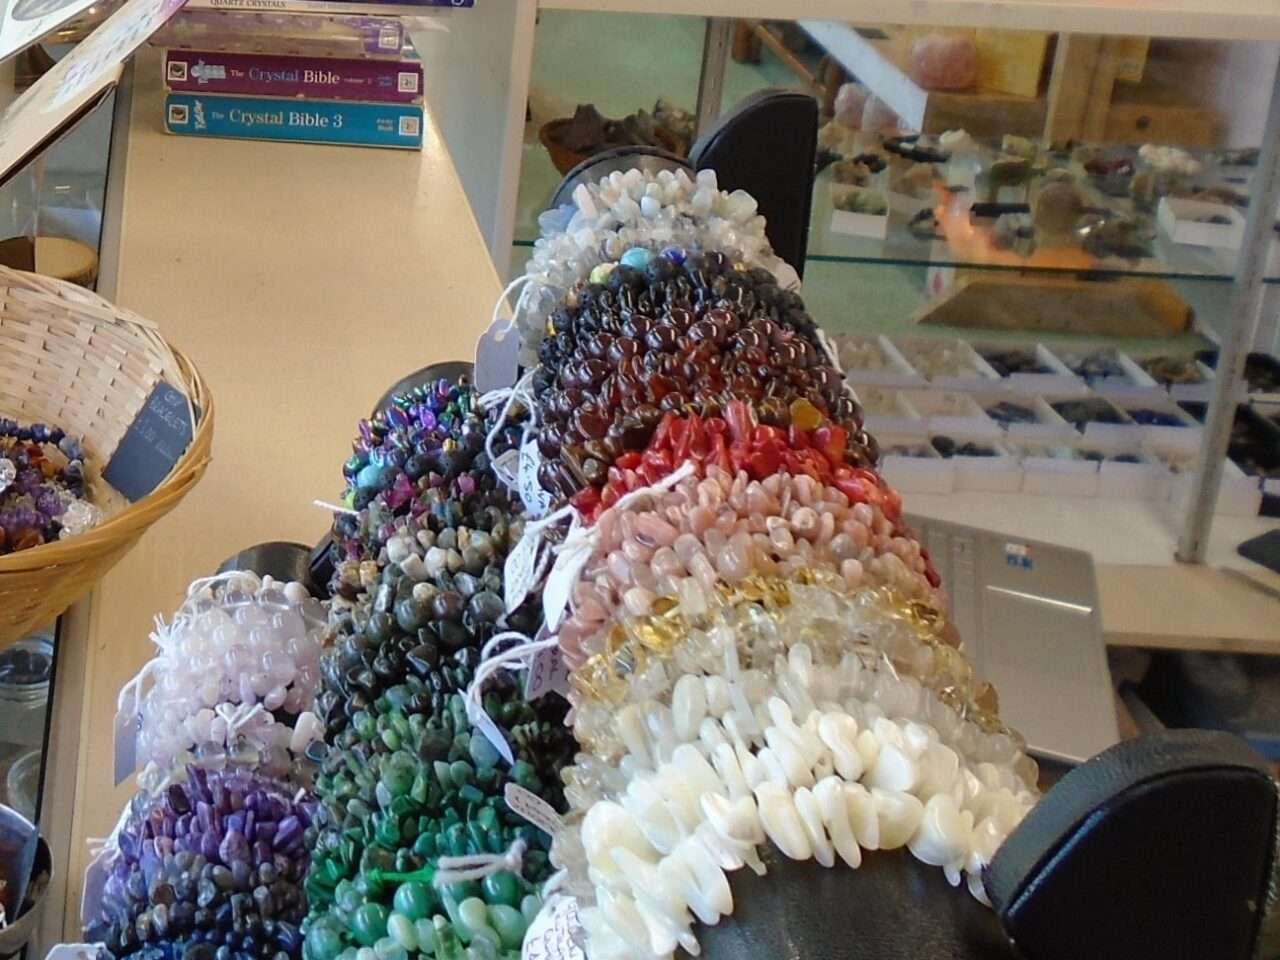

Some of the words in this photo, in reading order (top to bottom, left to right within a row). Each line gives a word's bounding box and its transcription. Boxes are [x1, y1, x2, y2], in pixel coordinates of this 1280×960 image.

[210, 0, 244, 7] QUARTZ
[246, 0, 287, 8] CRYSTALS
[231, 69, 245, 77] The
[248, 66, 298, 83] Crystal
[303, 69, 340, 84] Bible
[229, 109, 283, 127] Crystal
[288, 111, 329, 128] Bible
[332, 113, 343, 128] 3
